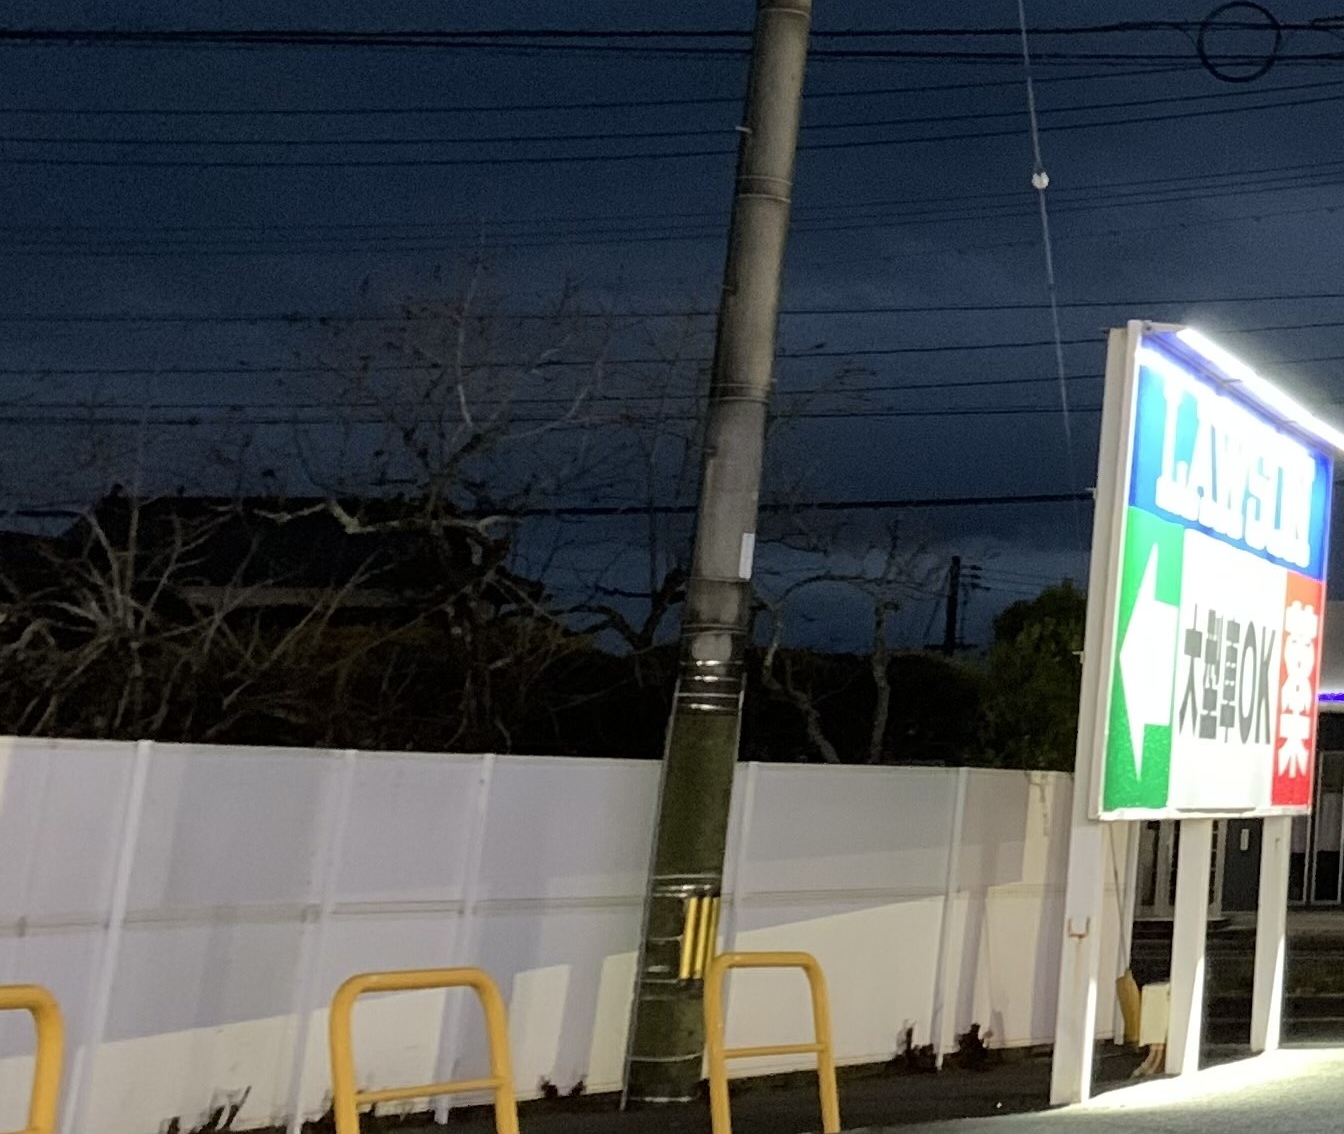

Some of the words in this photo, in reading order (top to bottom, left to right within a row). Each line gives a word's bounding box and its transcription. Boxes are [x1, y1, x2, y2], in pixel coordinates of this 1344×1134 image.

[1156, 378, 1316, 568] LAWSON
[1178, 604, 1277, 745] 大型車OK
